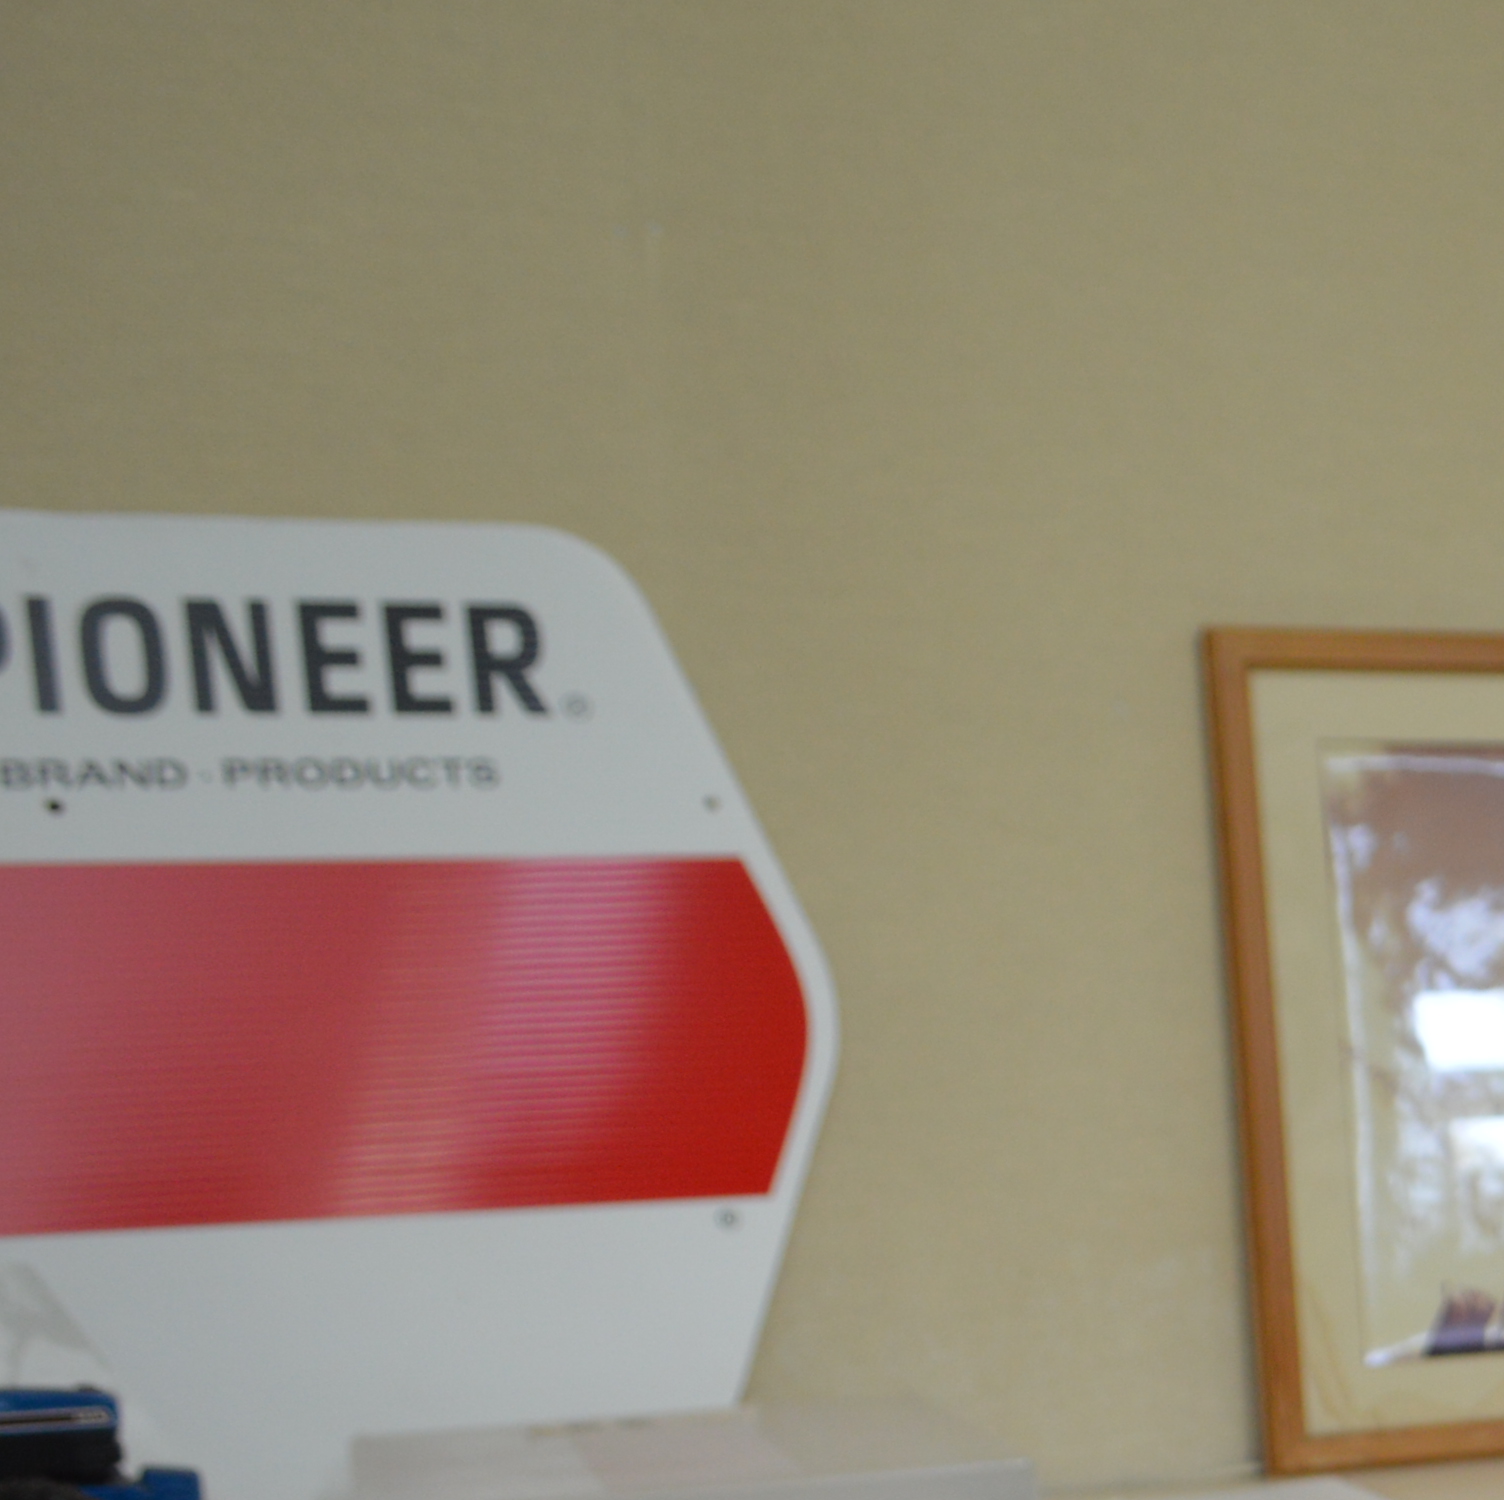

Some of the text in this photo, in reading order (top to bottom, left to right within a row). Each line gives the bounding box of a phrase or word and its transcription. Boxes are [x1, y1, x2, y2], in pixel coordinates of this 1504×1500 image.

[0, 595, 549, 716] IONEER
[0, 756, 501, 791] BRAND PRODUCTS
